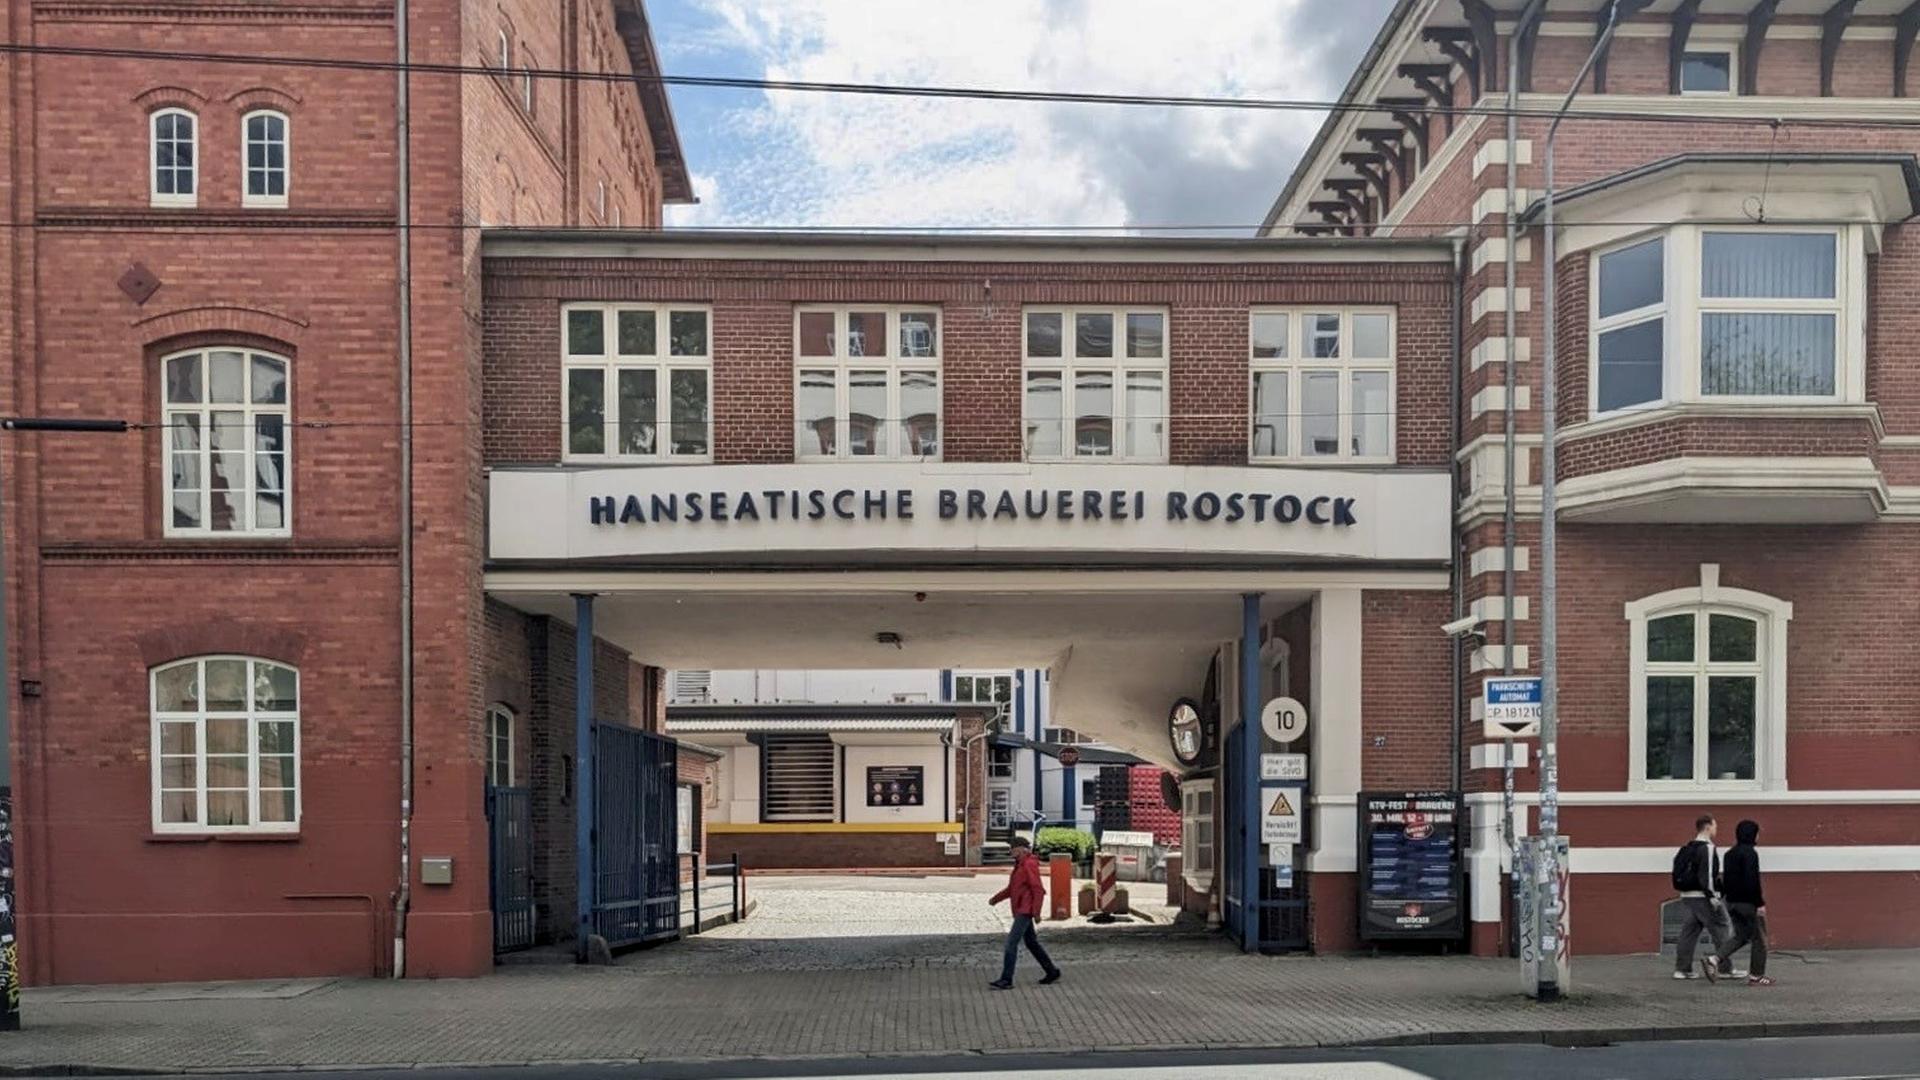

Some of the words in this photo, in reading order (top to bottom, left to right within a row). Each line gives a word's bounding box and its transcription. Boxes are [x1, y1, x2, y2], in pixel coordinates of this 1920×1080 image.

[590, 489, 915, 525] HANSEATISCHE
[938, 489, 1145, 521] BRAUEREI
[1165, 490, 1358, 526] ROSTOCK
[1491, 682, 1538, 691] PARKSCHEIN-
[1499, 691, 1530, 701] AUTOMAT
[1274, 710, 1295, 730] 10
[1369, 800, 1408, 810] KTV-FEST
